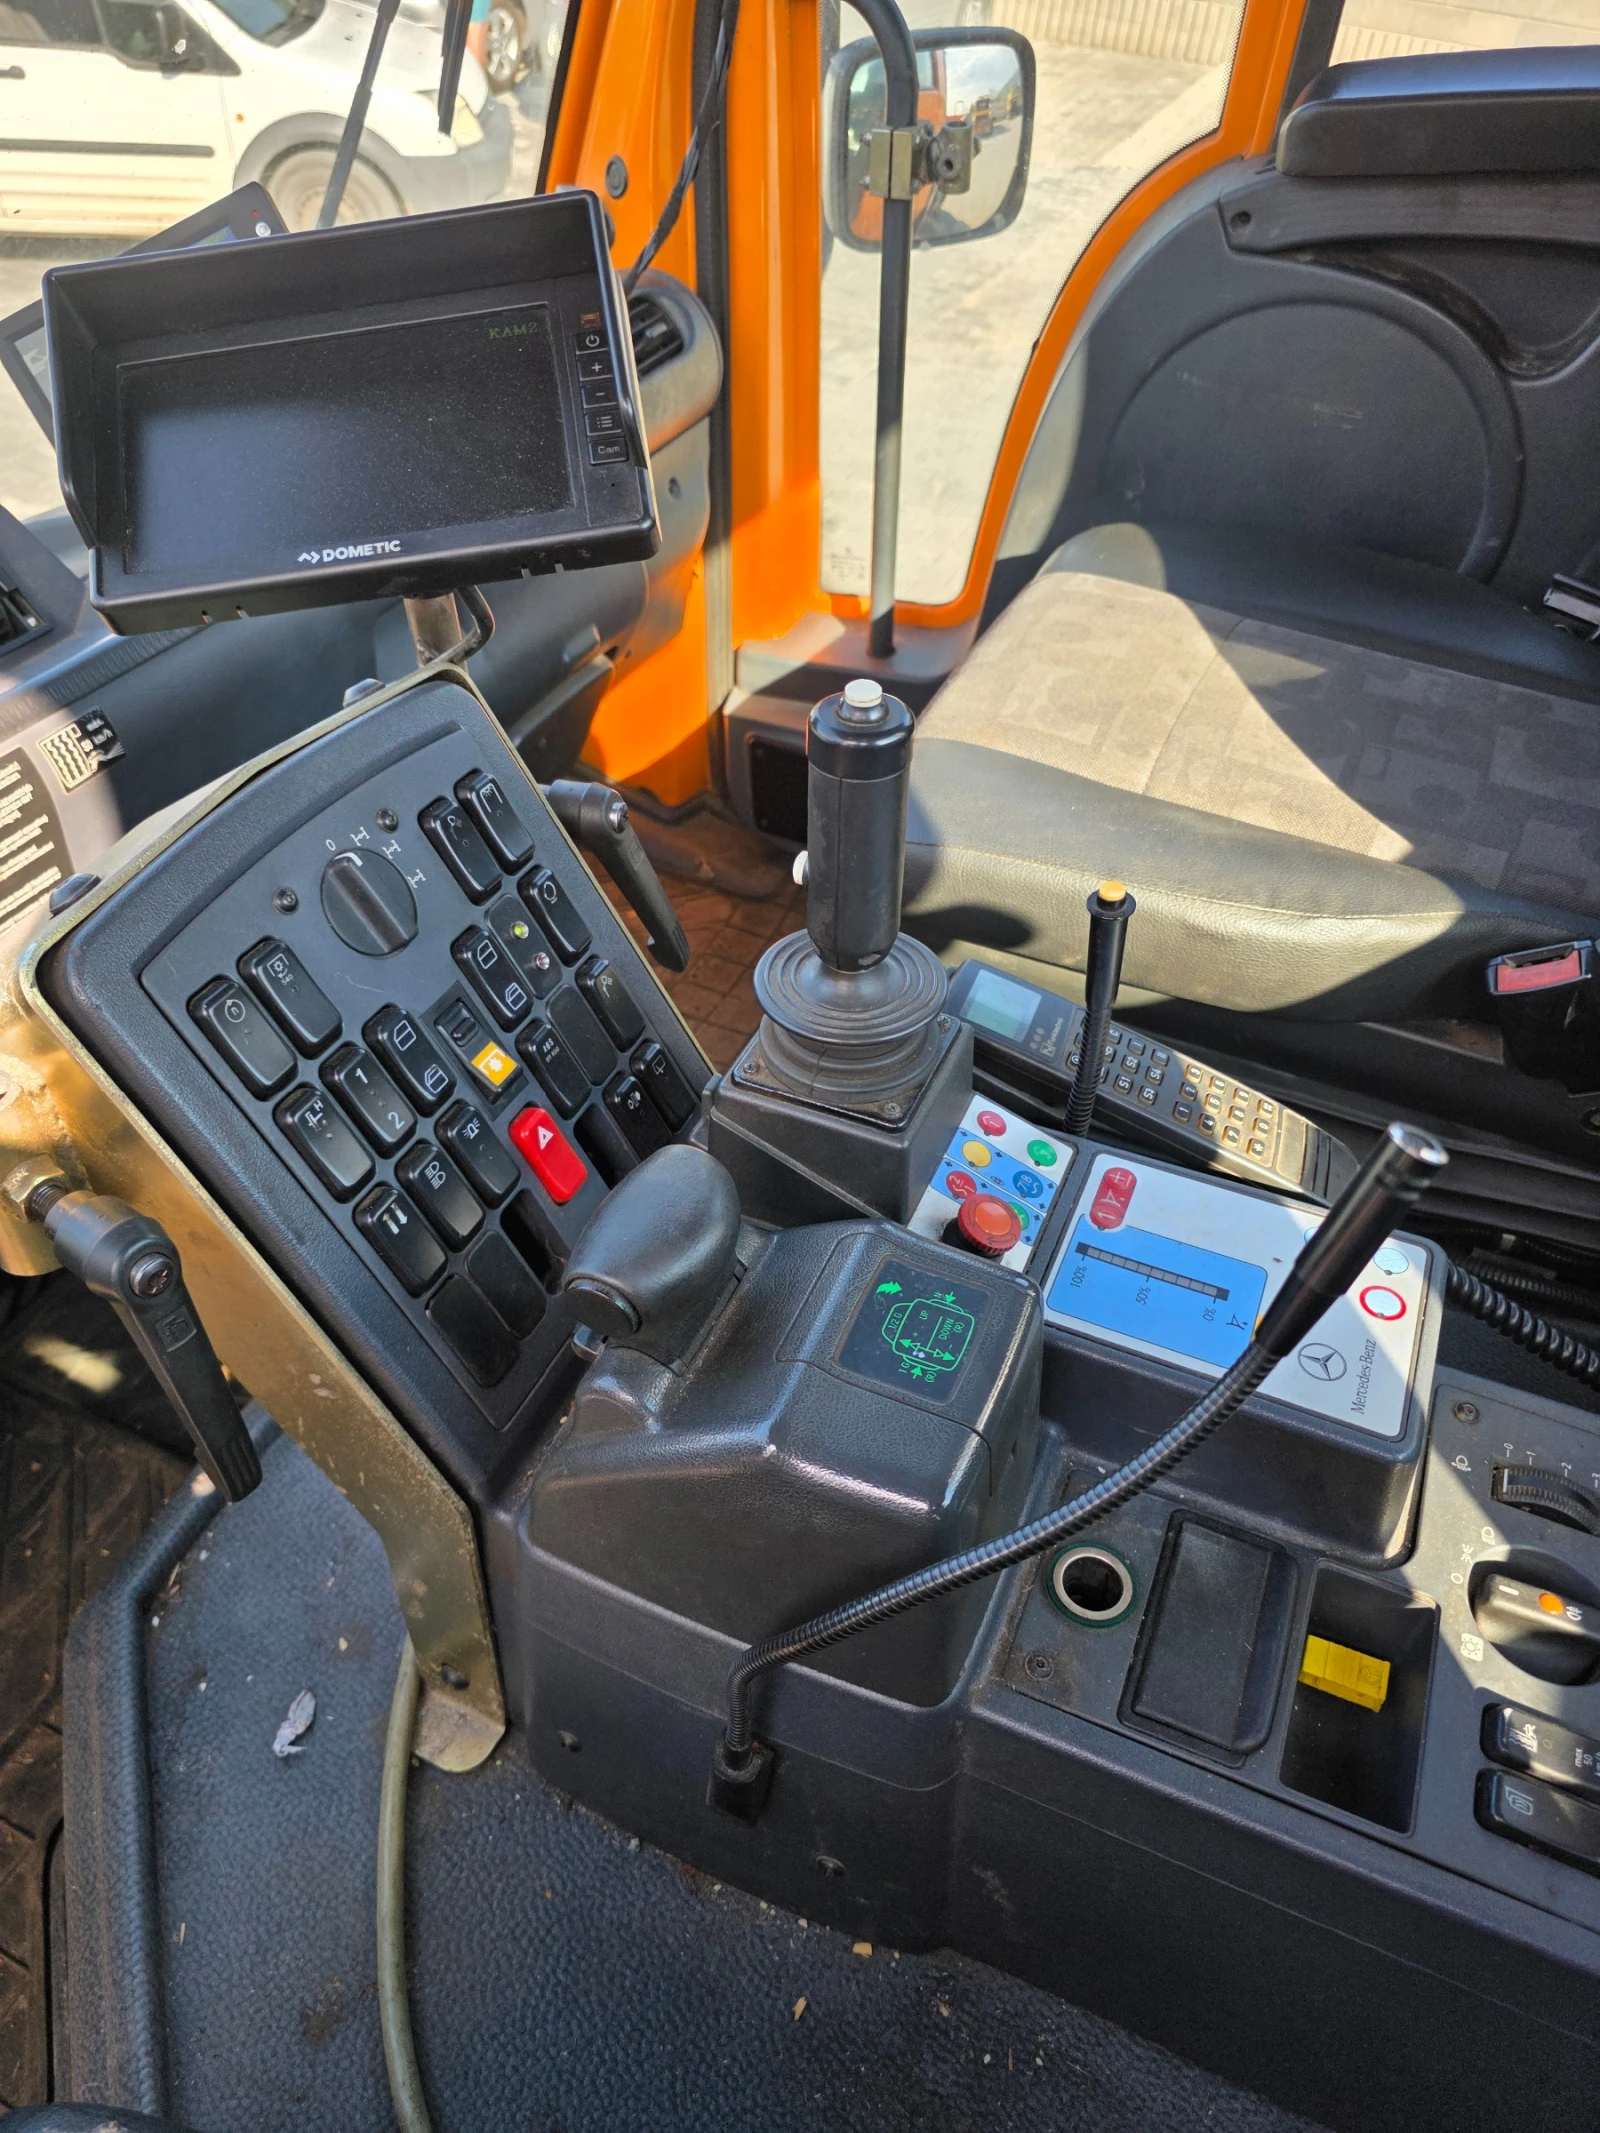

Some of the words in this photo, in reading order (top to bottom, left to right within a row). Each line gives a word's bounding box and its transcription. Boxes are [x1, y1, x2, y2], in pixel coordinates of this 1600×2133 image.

[597, 445, 620, 455] Cam
[322, 540, 401, 562] DOMETIC
[1109, 1029, 1119, 1037] C
[542, 1037, 554, 1053] ABS
[1125, 1056, 1138, 1069] S2
[355, 1067, 368, 1084] 1
[1150, 1067, 1162, 1080] S4
[1190, 1067, 1201, 1075] 3
[1118, 1076, 1131, 1089] S1
[1214, 1079, 1225, 1087] 6
[1143, 1087, 1155, 1100] S3
[1238, 1090, 1249, 1098] 9
[1209, 1097, 1220, 1106] 5
[388, 1112, 405, 1129] 2
[1233, 1110, 1244, 1118] 8
[1258, 1121, 1269, 1130] 0
[1228, 1131, 1239, 1139] 7
[1069, 1265, 1088, 1289] 100%
[1136, 1286, 1150, 1305] 50%
[919, 1310, 929, 1320] UP
[1202, 1307, 1216, 1322] 0%
[938, 1318, 954, 1340] DOWN
[953, 1322, 965, 1333] (R)
[924, 1371, 937, 1383] (R)
[1350, 1338, 1377, 1415] Mercedes-Benz
[1575, 1748, 1583, 1767] max
[1583, 1754, 1593, 1766] 50
